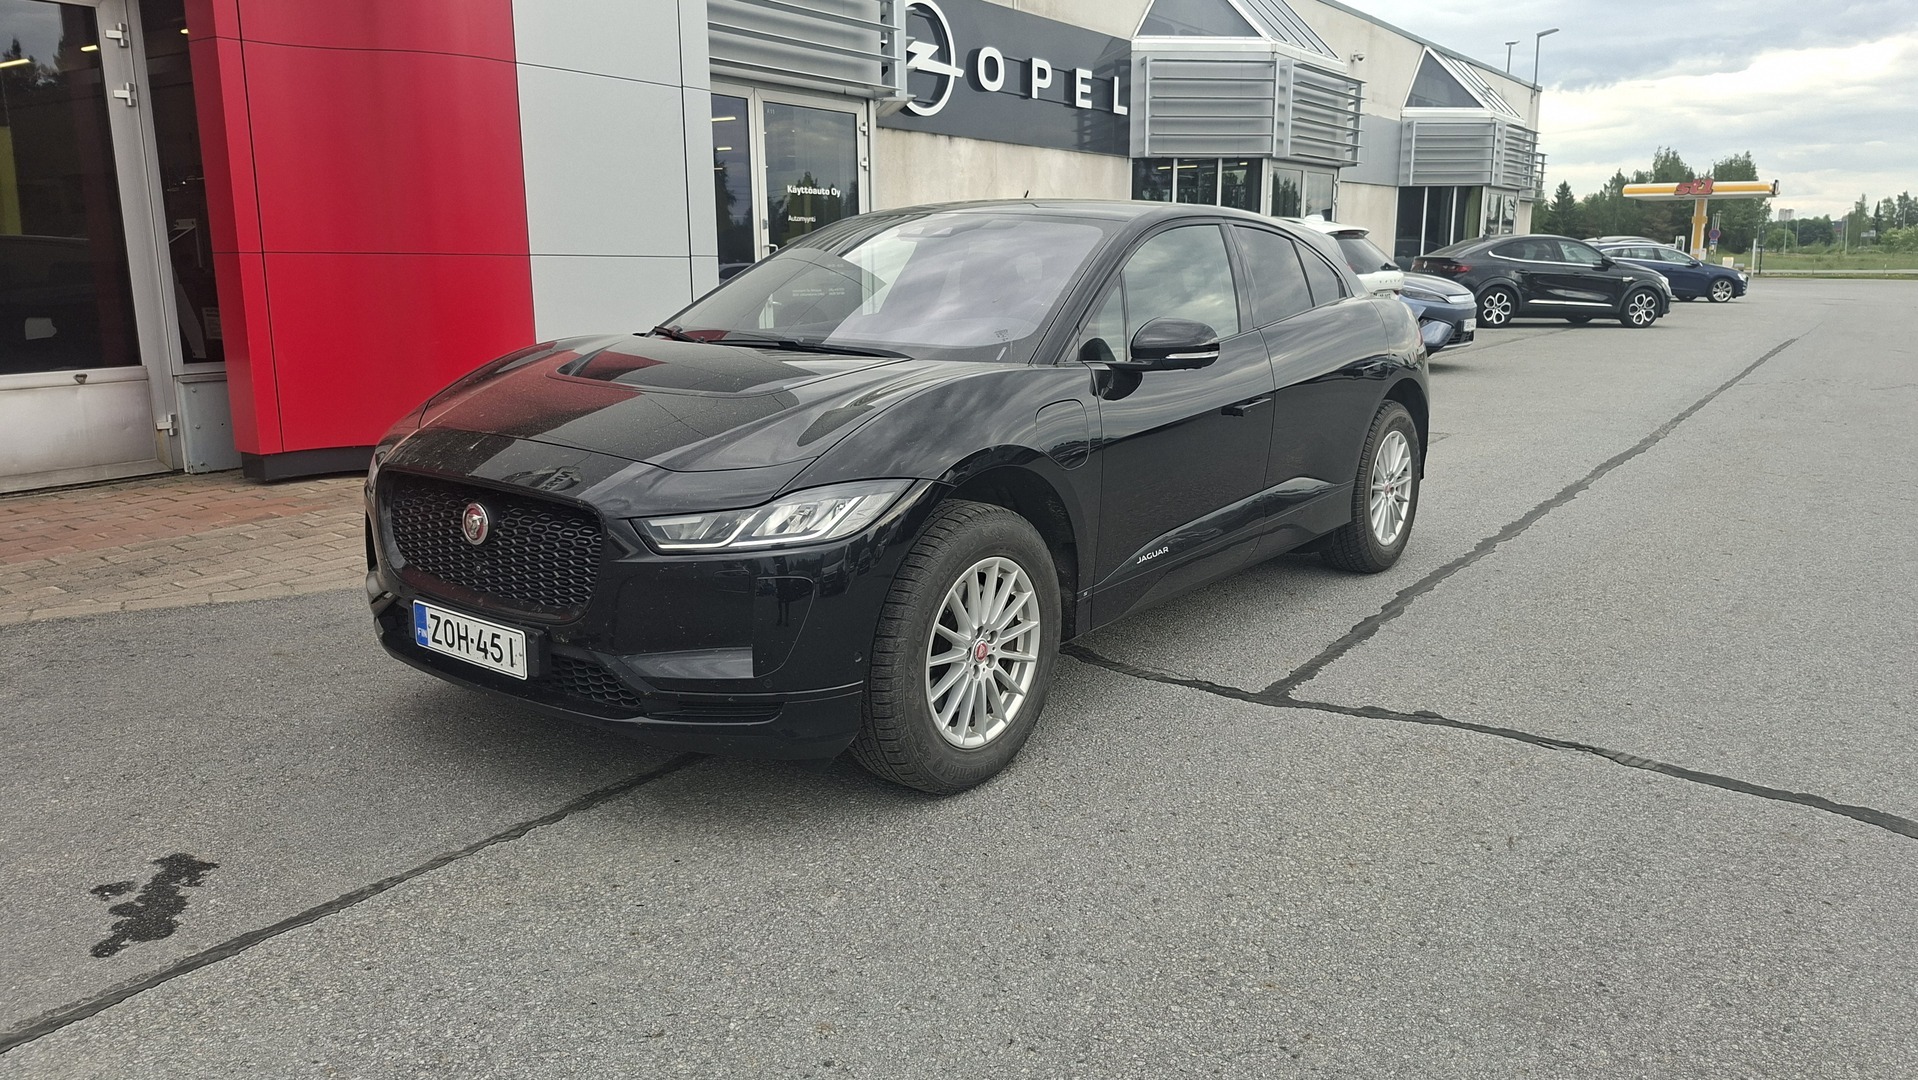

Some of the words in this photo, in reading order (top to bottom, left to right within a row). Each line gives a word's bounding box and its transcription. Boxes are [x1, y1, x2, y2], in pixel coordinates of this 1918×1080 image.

[977, 46, 1128, 116] OPEL
[787, 184, 830, 196] Käyttöauto
[831, 188, 841, 198] Oy
[788, 215, 817, 224] Automyynti
[1136, 546, 1169, 565] JAGUAR
[429, 613, 514, 668] ZOH-451
